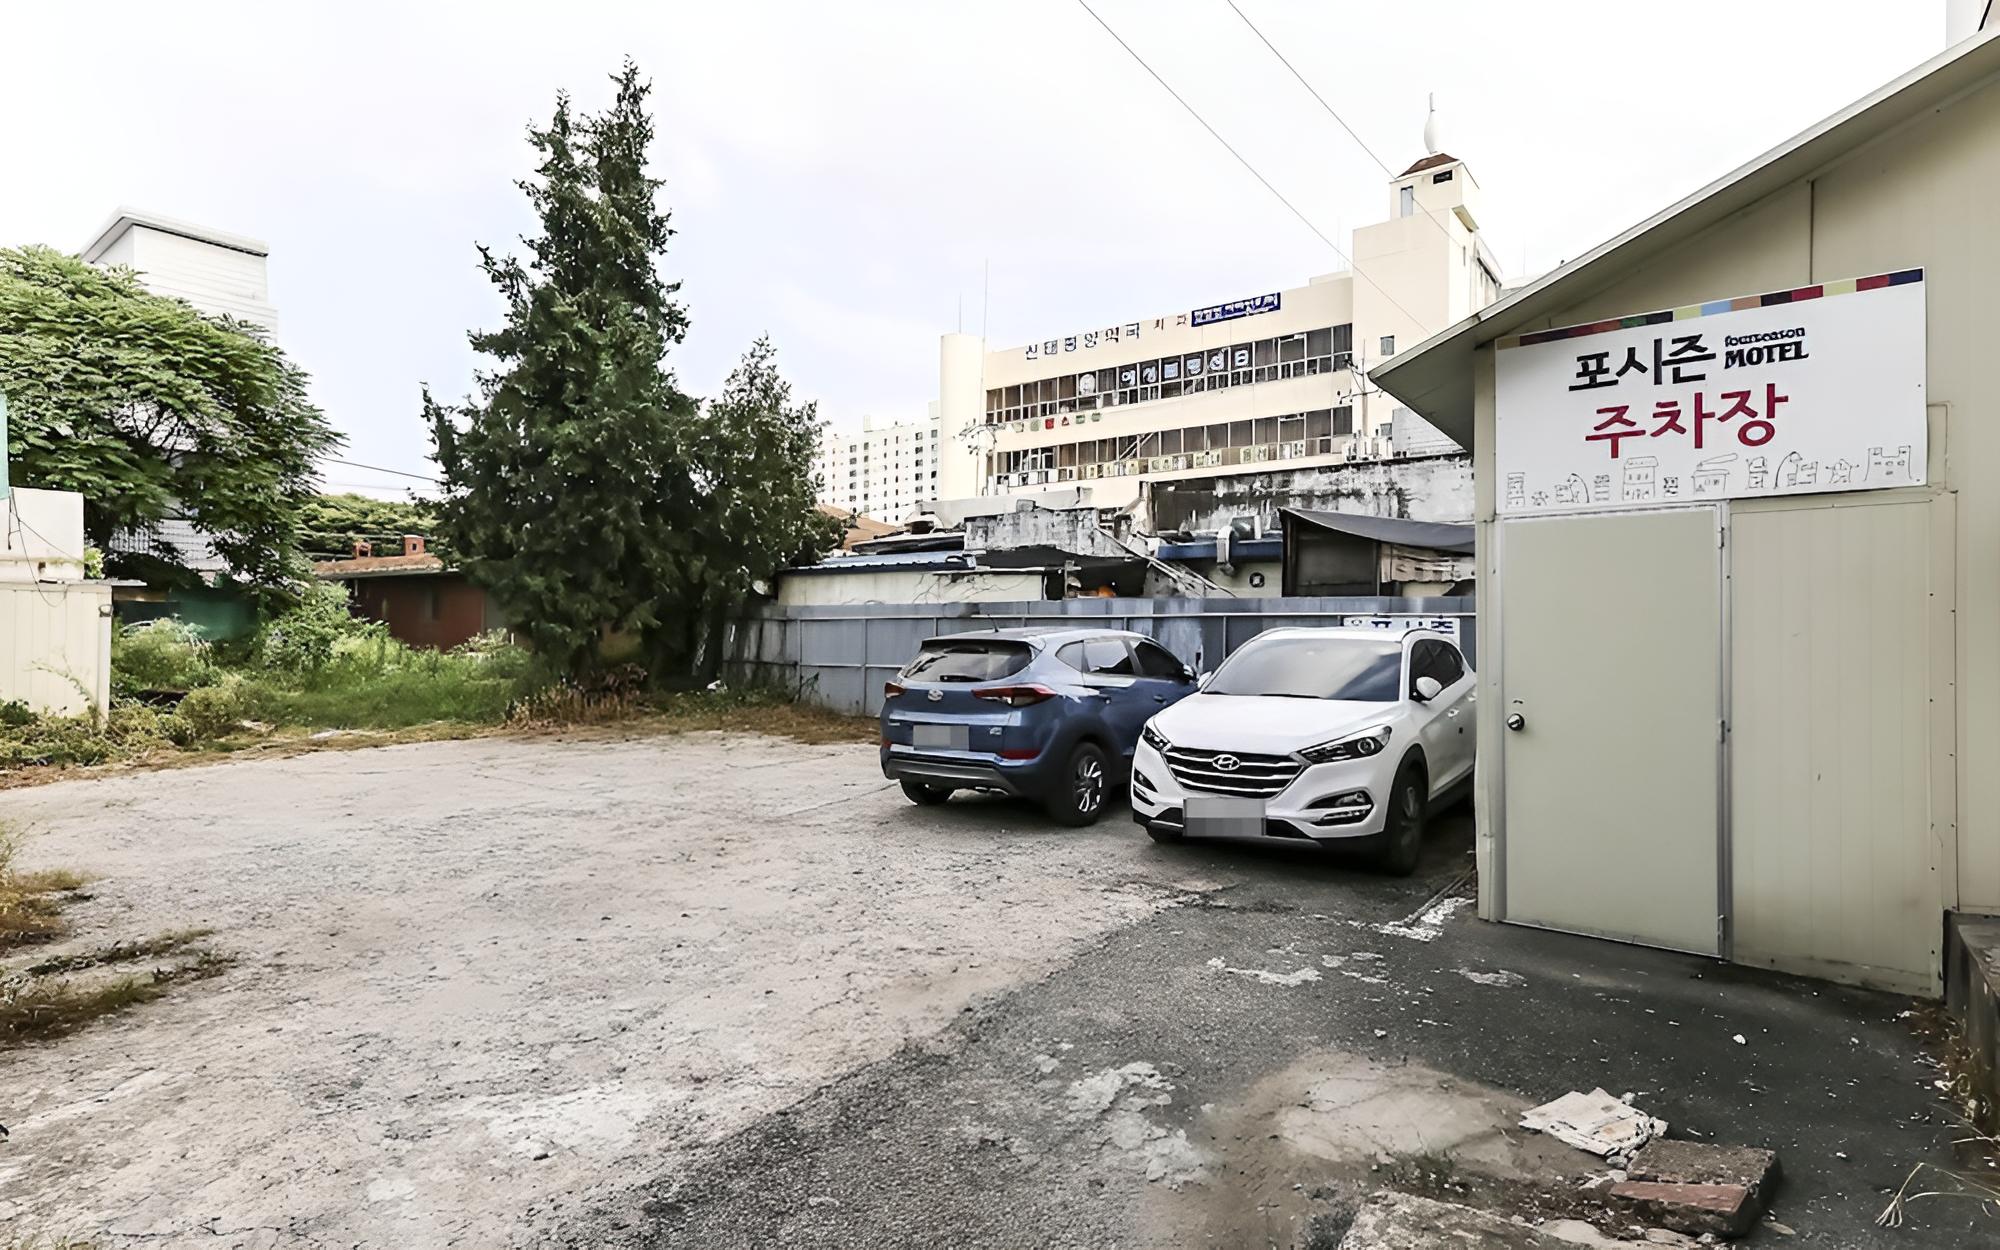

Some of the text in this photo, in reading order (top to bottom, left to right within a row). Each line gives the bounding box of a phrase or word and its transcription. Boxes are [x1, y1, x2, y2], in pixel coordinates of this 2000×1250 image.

[1568, 333, 1717, 392] 포시즌
[1723, 340, 1809, 370] MOTEL
[1585, 383, 1789, 459] 주차장
